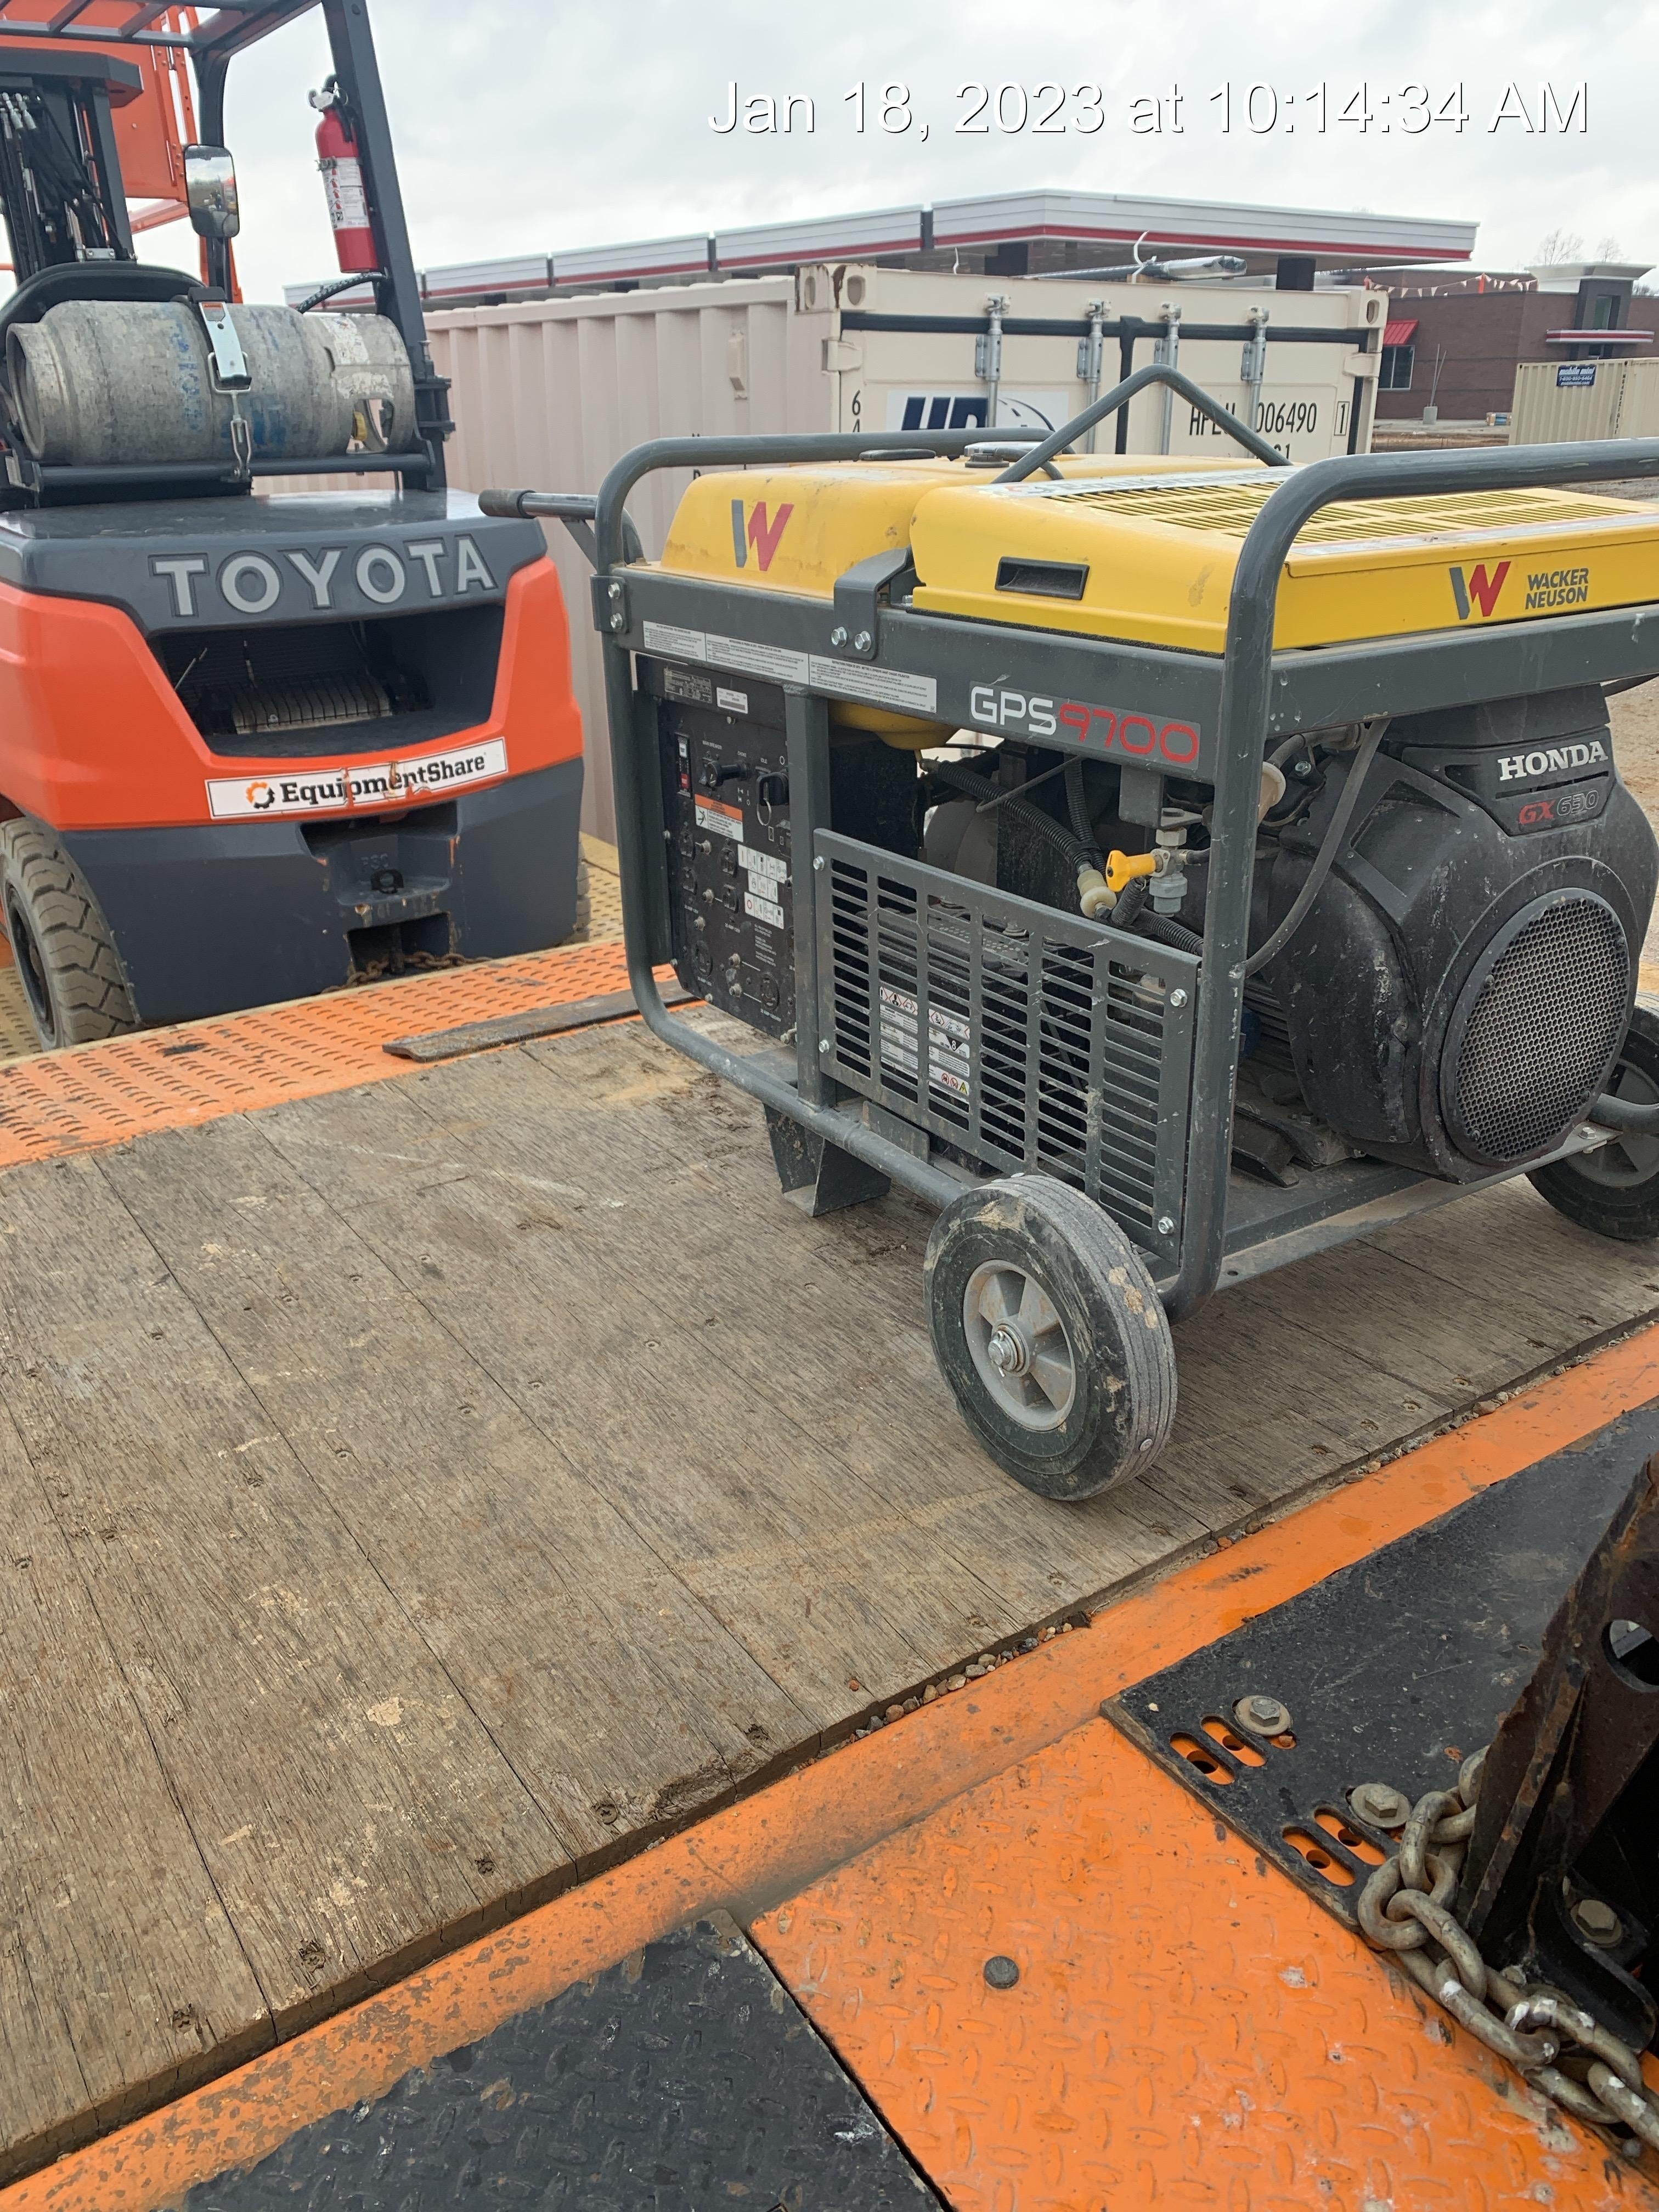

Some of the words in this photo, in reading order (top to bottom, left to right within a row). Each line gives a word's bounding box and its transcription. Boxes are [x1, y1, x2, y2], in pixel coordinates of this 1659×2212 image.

[1559, 366, 1581, 375] mobile
[1579, 366, 1595, 375] mini
[154, 537, 495, 616] TOYOTA
[1527, 567, 1589, 591] WACKER
[1525, 585, 1588, 610] NEUSON
[1497, 741, 1609, 781] HONDA
[280, 753, 486, 805] EquipmentShare
[951, 1040, 957, 1051] 8
